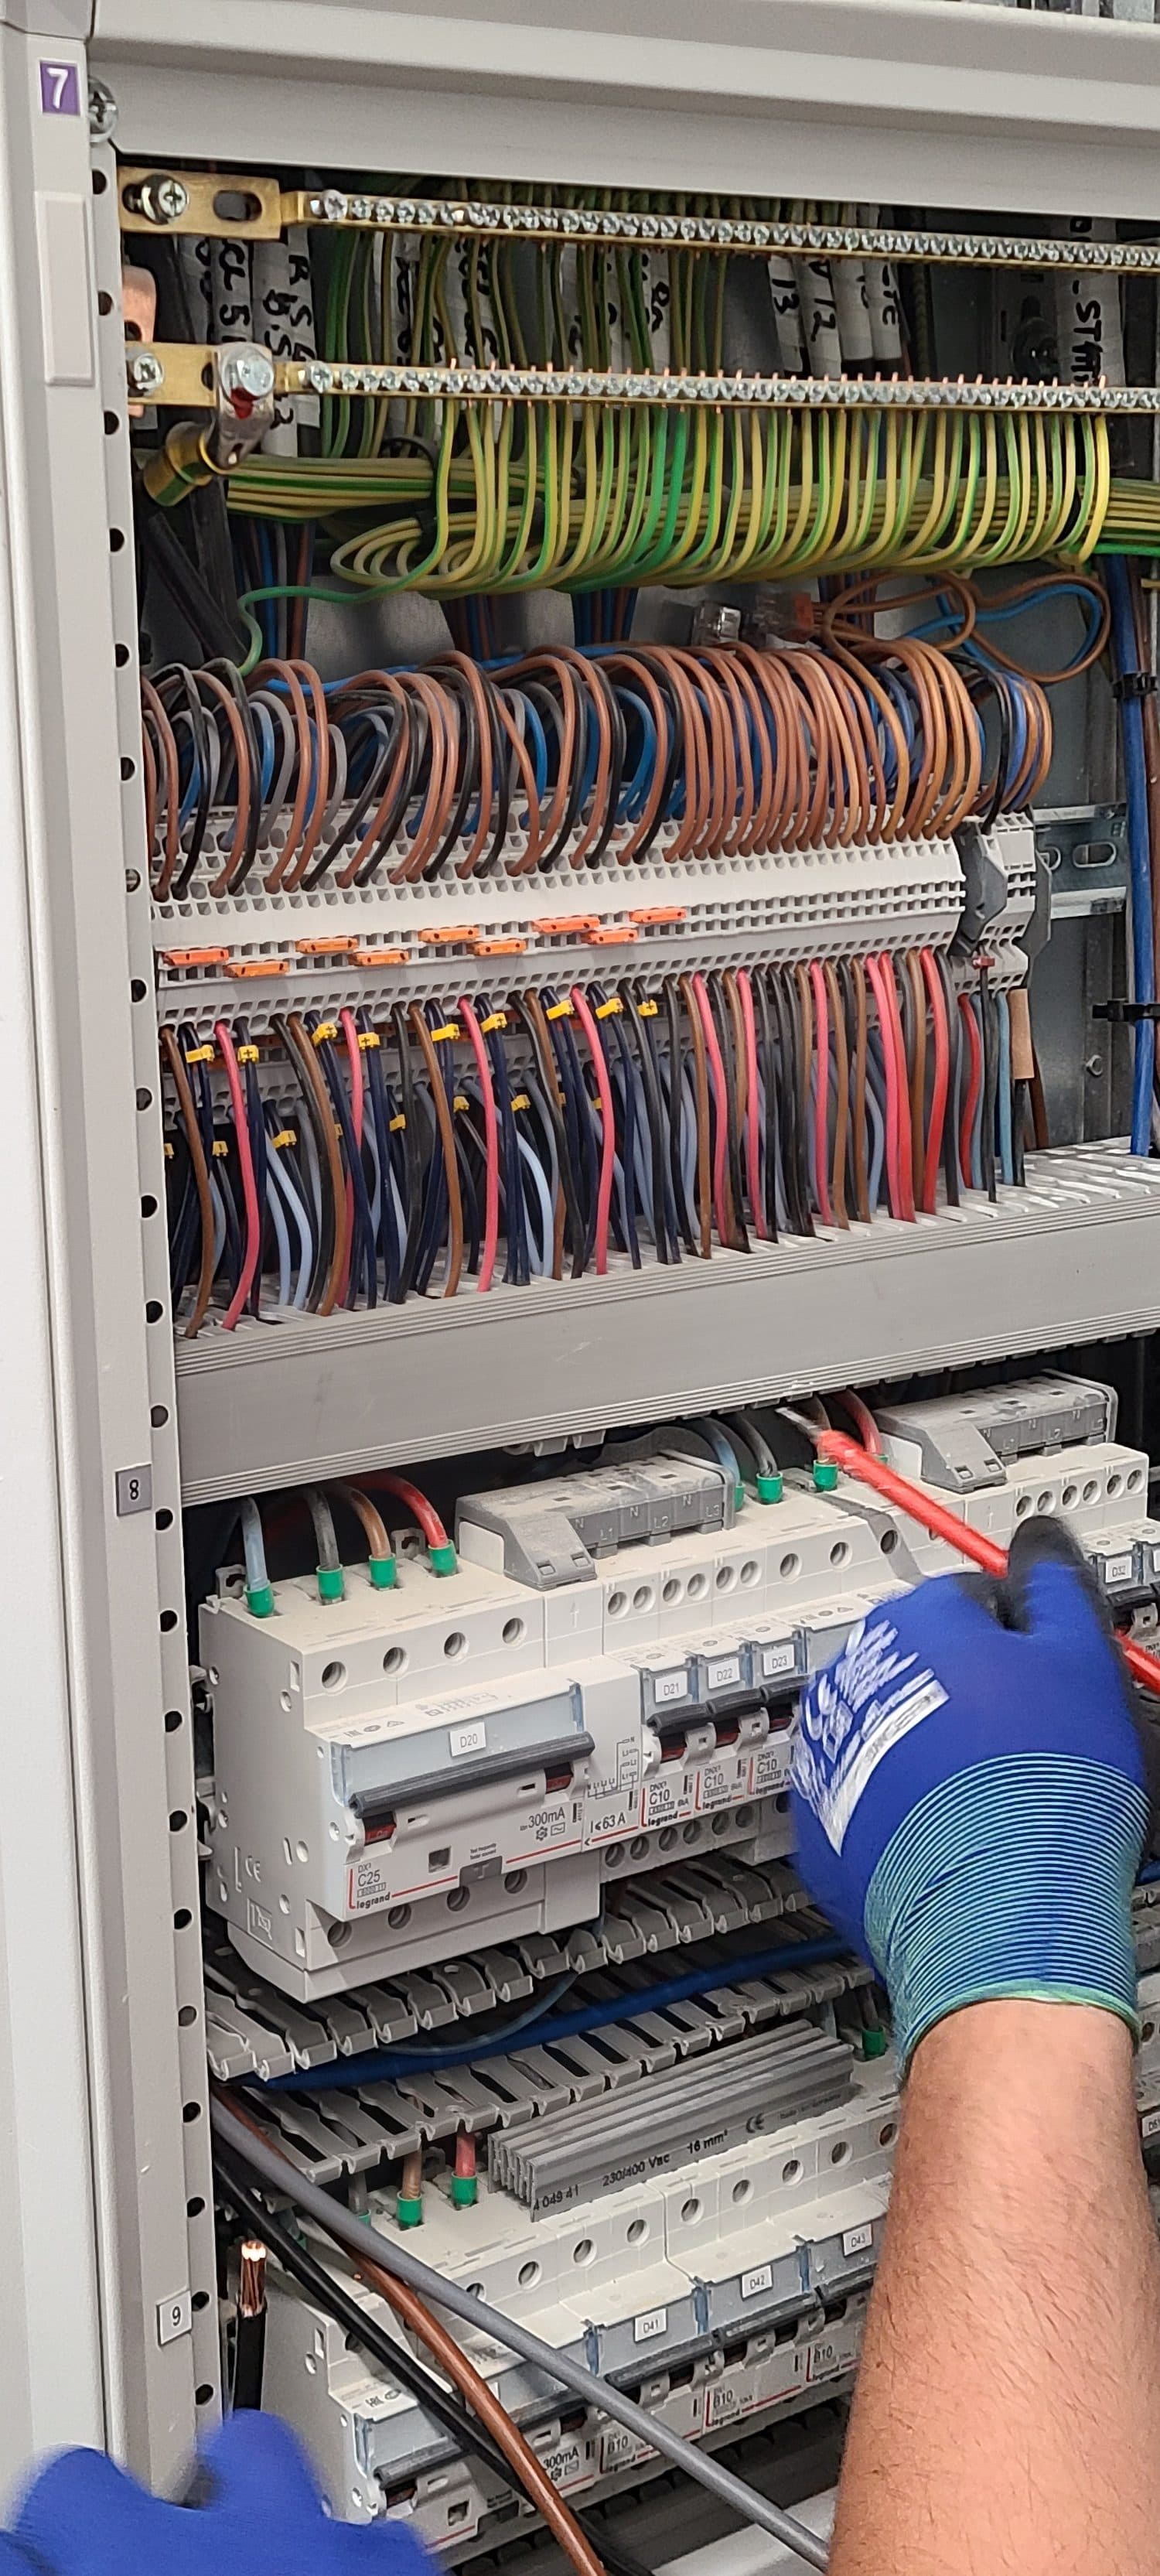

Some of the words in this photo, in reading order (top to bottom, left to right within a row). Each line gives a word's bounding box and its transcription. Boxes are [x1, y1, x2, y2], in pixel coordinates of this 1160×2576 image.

[46, 67, 69, 109] 7
[772, 278, 800, 314] 13
[129, 1479, 139, 1500] 8
[629, 1506, 639, 1517] N
[654, 1516, 669, 1529] L2
[772, 1655, 788, 1669] D23
[716, 1668, 732, 1682] D22
[663, 1682, 680, 1696] D21
[459, 1733, 478, 1748] D20
[757, 1758, 777, 1774] C10
[704, 1772, 724, 1789] C10
[649, 1789, 670, 1806] C10
[528, 1807, 565, 1828] 300mA
[358, 1869, 380, 1887] C25
[357, 1891, 391, 1909] legrand
[542, 2189, 564, 2208] 049
[602, 2161, 646, 2188] 230/400
[749, 2274, 766, 2291] D42
[172, 2305, 182, 2327] 9
[643, 2318, 659, 2334] D41
